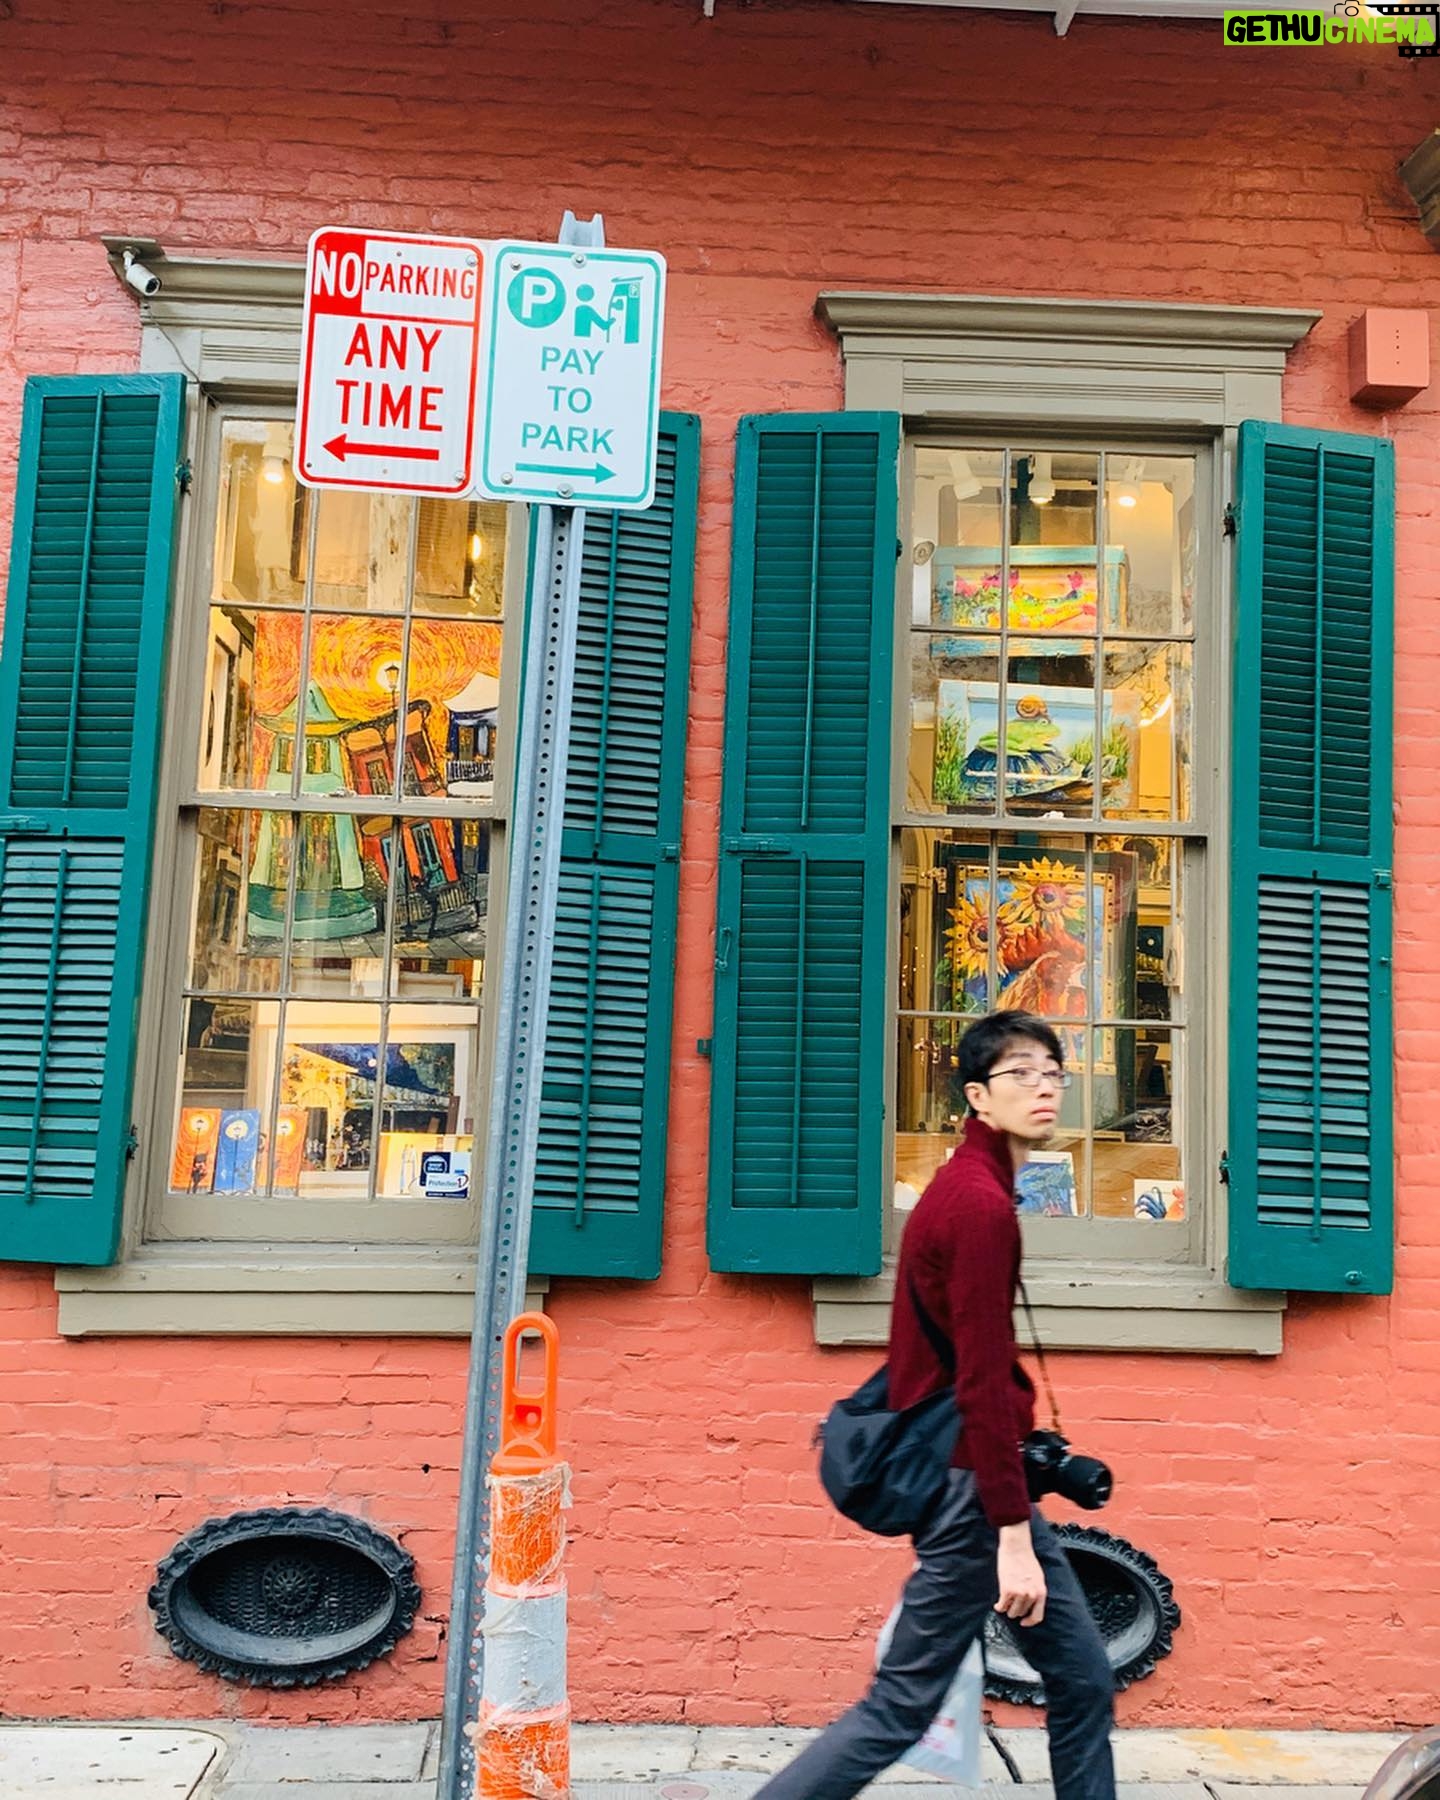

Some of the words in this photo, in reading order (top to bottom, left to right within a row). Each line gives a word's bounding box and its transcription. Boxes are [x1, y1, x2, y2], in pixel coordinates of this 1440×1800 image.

[313, 250, 362, 298] NO
[365, 261, 475, 300] PARKING
[521, 275, 556, 319] P
[344, 323, 443, 372] ANY
[540, 346, 604, 375] PAY
[335, 379, 444, 431] TIME
[547, 385, 592, 413] TO
[521, 422, 615, 454] PARK
